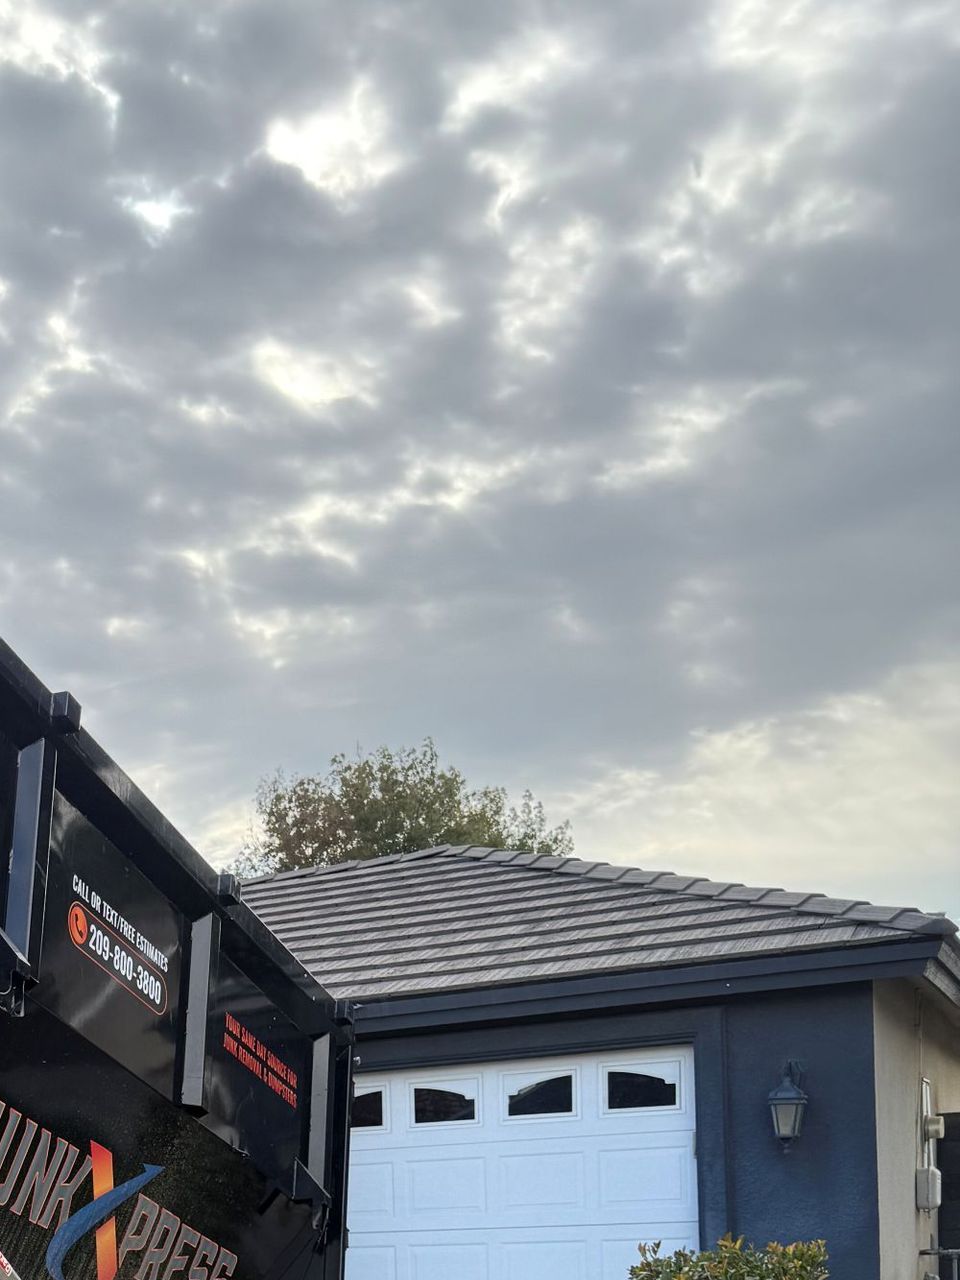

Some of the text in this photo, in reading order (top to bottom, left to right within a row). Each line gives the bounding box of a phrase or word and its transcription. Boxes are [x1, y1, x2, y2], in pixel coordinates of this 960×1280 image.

[72, 874, 169, 973] CALL OR TEXT/FREE ESTIMATES
[88, 924, 161, 1005] 209-800-3800
[223, 1032, 238, 1058] JUNK
[238, 1045, 262, 1079] REMOVAL
[268, 1071, 298, 1109] DUMPSTERS
[241, 1026, 256, 1052] SAME
[256, 1039, 267, 1061] DAY
[267, 1050, 287, 1080] SOURCE
[287, 1068, 298, 1089] FOR
